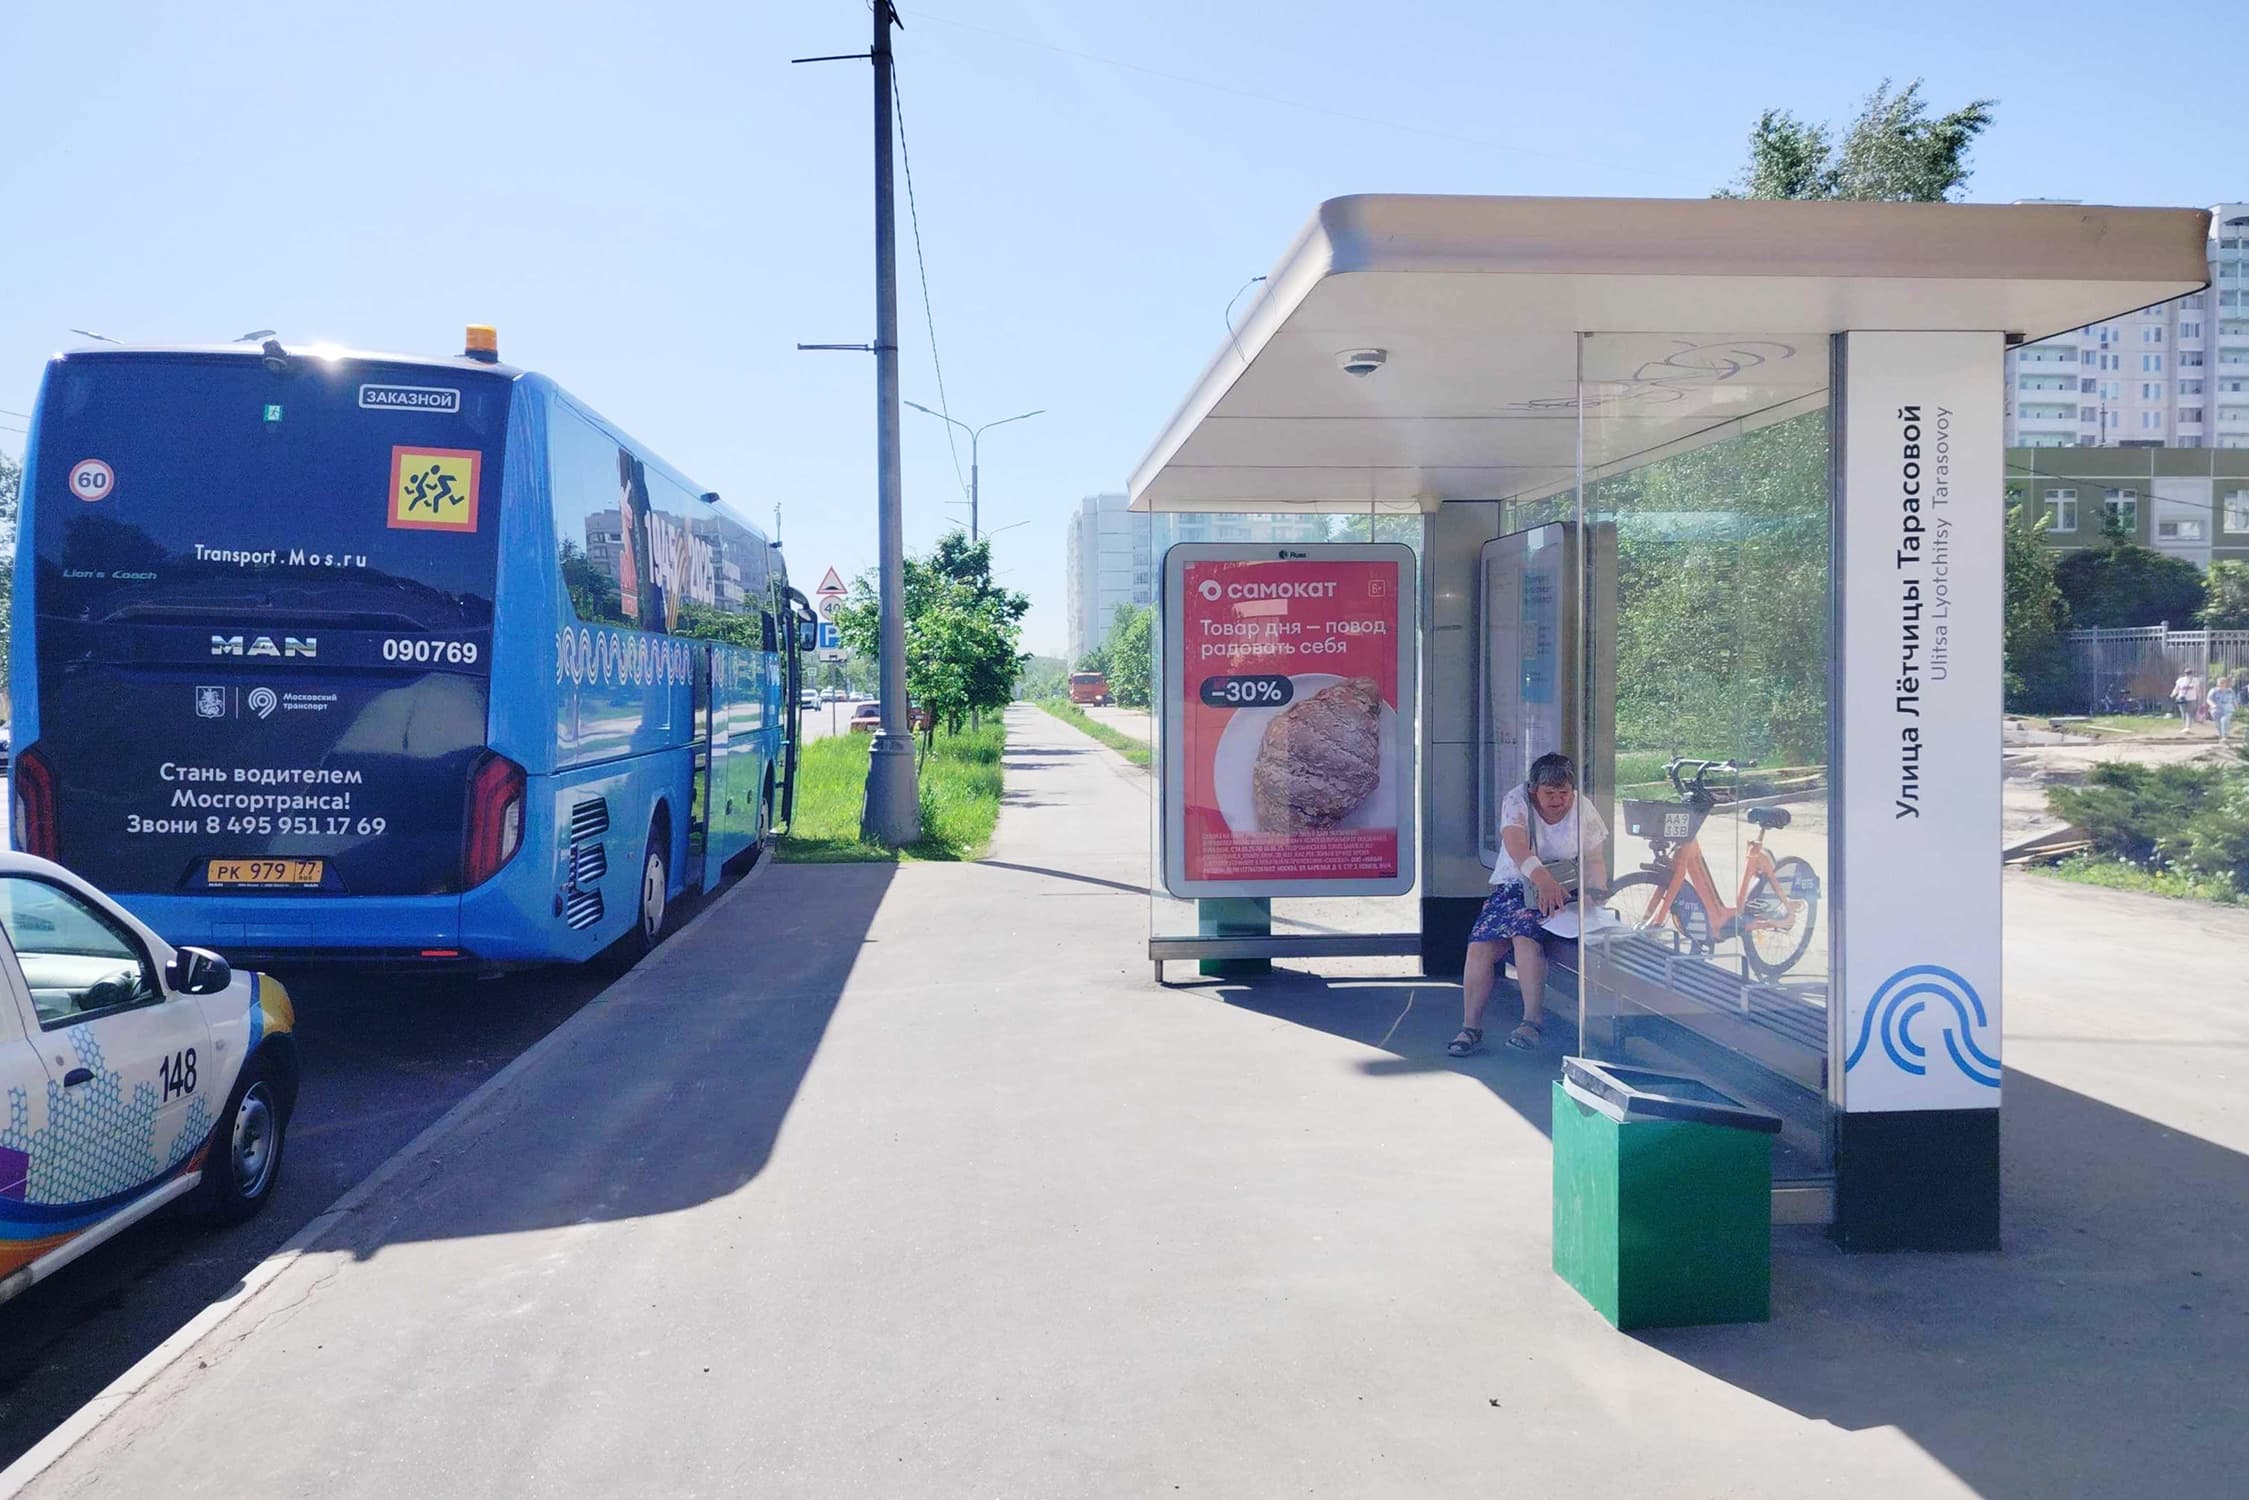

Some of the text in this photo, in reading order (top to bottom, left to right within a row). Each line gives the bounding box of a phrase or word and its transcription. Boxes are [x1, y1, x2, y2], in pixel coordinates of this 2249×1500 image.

[366, 391, 453, 408] ЗАКАЗНОЙ
[77, 471, 107, 489] 60
[1931, 406, 1954, 680] Ulitsa Lyotchitsy Tarasovoy
[111, 570, 158, 580] Coach
[1227, 582, 1337, 599] самокат
[1896, 405, 1926, 820] Улица Лётчицы Тарасовой
[1200, 619, 1260, 639] Товар
[1265, 621, 1301, 637] дня
[1326, 620, 1387, 635] повод
[211, 635, 317, 657] MAN
[382, 639, 478, 664] 090769
[1201, 637, 1347, 659] радовать себя
[283, 692, 337, 702] Московский
[283, 702, 328, 712] транспорт
[159, 762, 363, 786] Стань водителем
[171, 789, 351, 813] Мосгортранса!
[127, 814, 387, 836] Звони 8 495 951 17 69
[250, 862, 286, 880] 979
[298, 861, 316, 875] 77
[159, 1047, 197, 1103] 148
